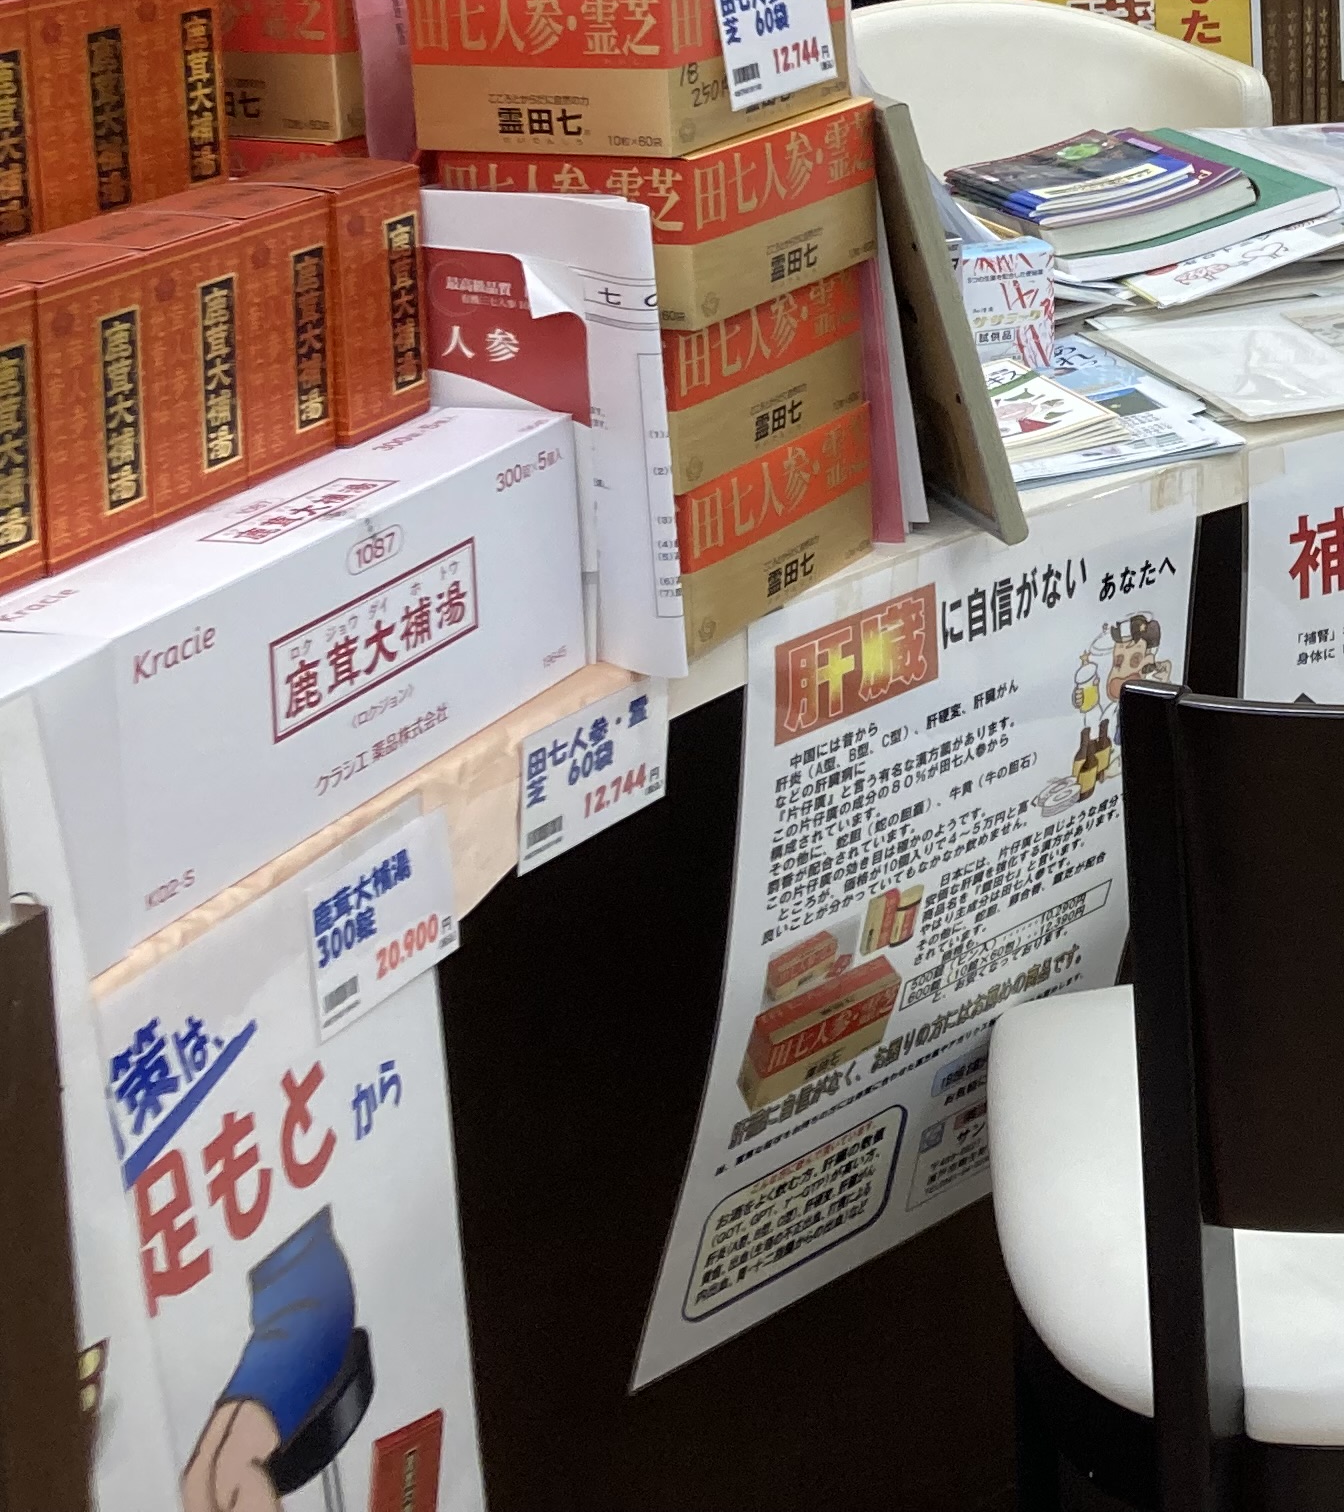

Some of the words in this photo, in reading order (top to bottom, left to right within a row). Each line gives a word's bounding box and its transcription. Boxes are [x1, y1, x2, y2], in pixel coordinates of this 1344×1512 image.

[978, 330, 1012, 343] 試供品
[354, 532, 396, 568] 1087
[132, 624, 218, 684] Kracie
[284, 579, 468, 720] 鹿茸大補湯
[781, 591, 928, 739] 肝臓
[942, 557, 1088, 652] に自信がない
[1099, 559, 1178, 604] あなたへ
